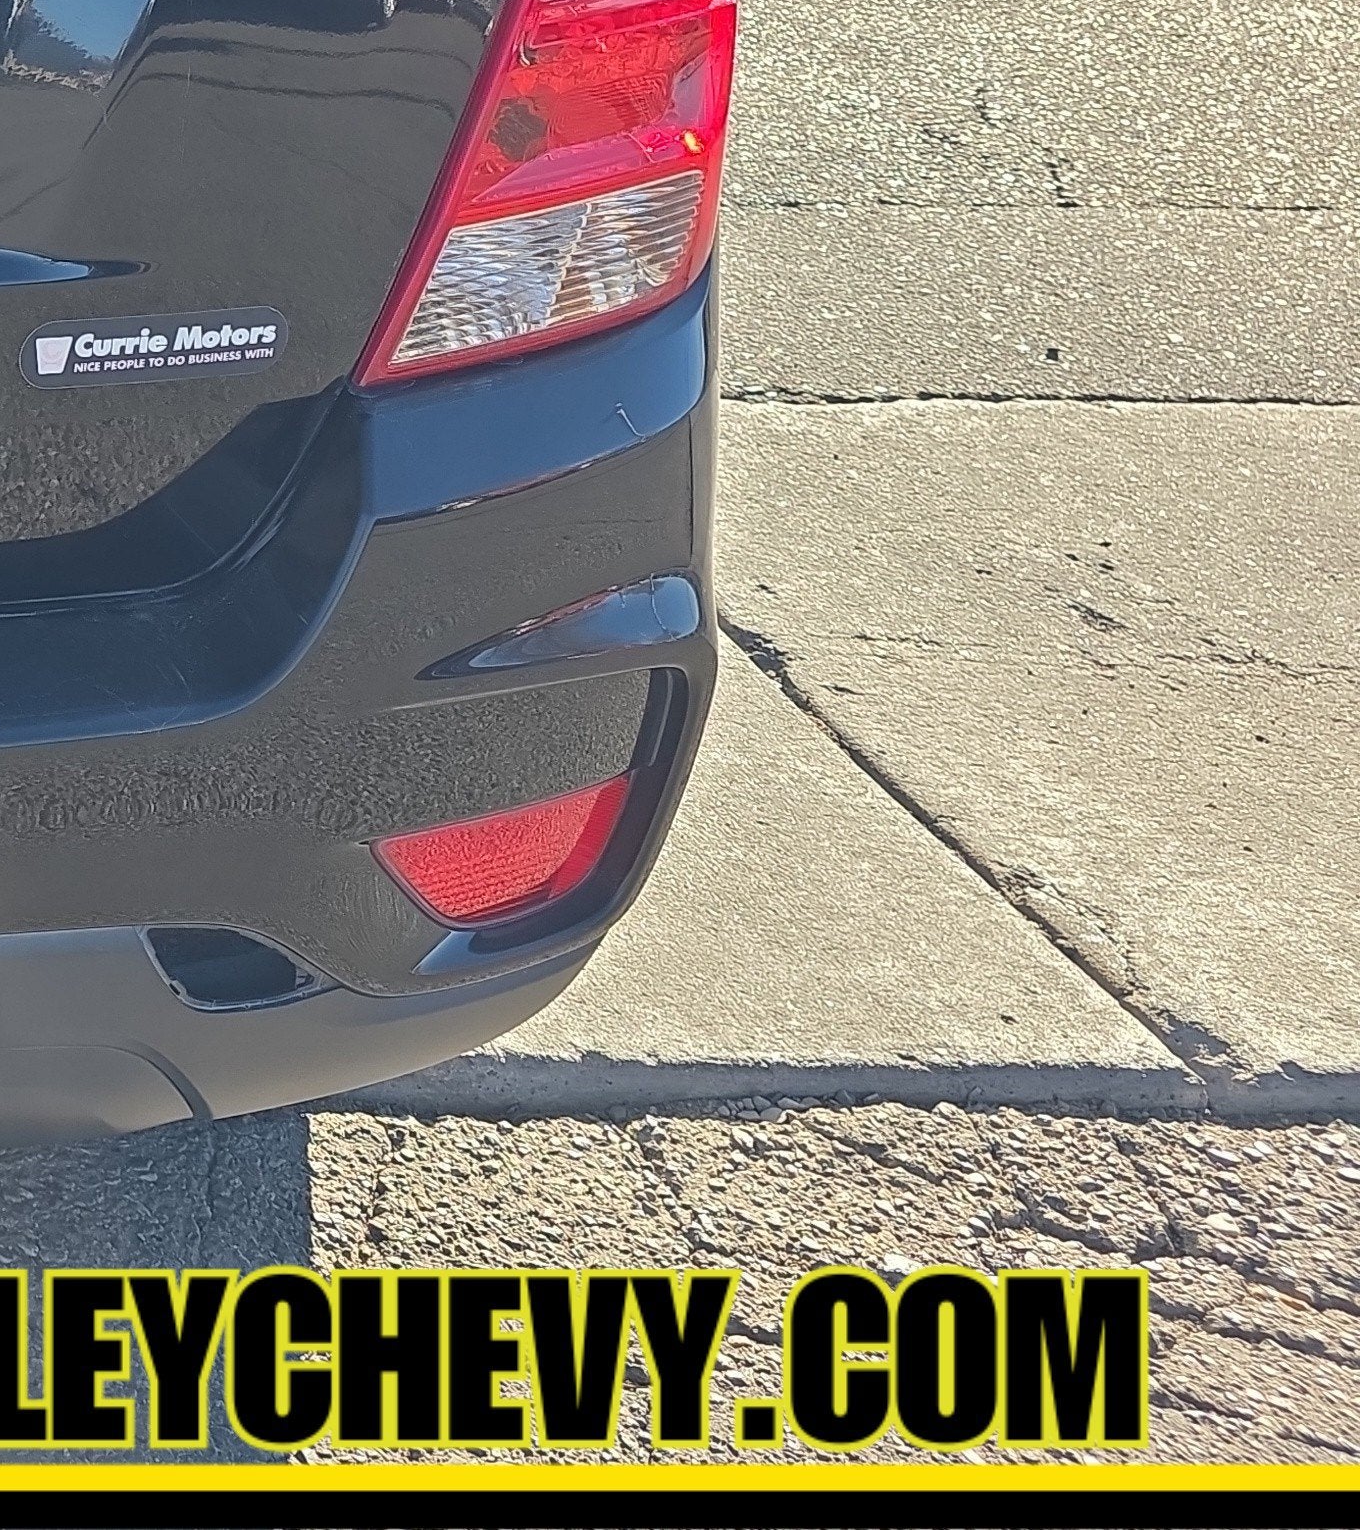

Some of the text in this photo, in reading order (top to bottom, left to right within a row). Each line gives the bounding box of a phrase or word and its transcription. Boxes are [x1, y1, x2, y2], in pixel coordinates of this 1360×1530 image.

[74, 324, 277, 358] Currie Motors
[73, 347, 274, 373] NICE PEOPLE TO DO BUSINESS WITH
